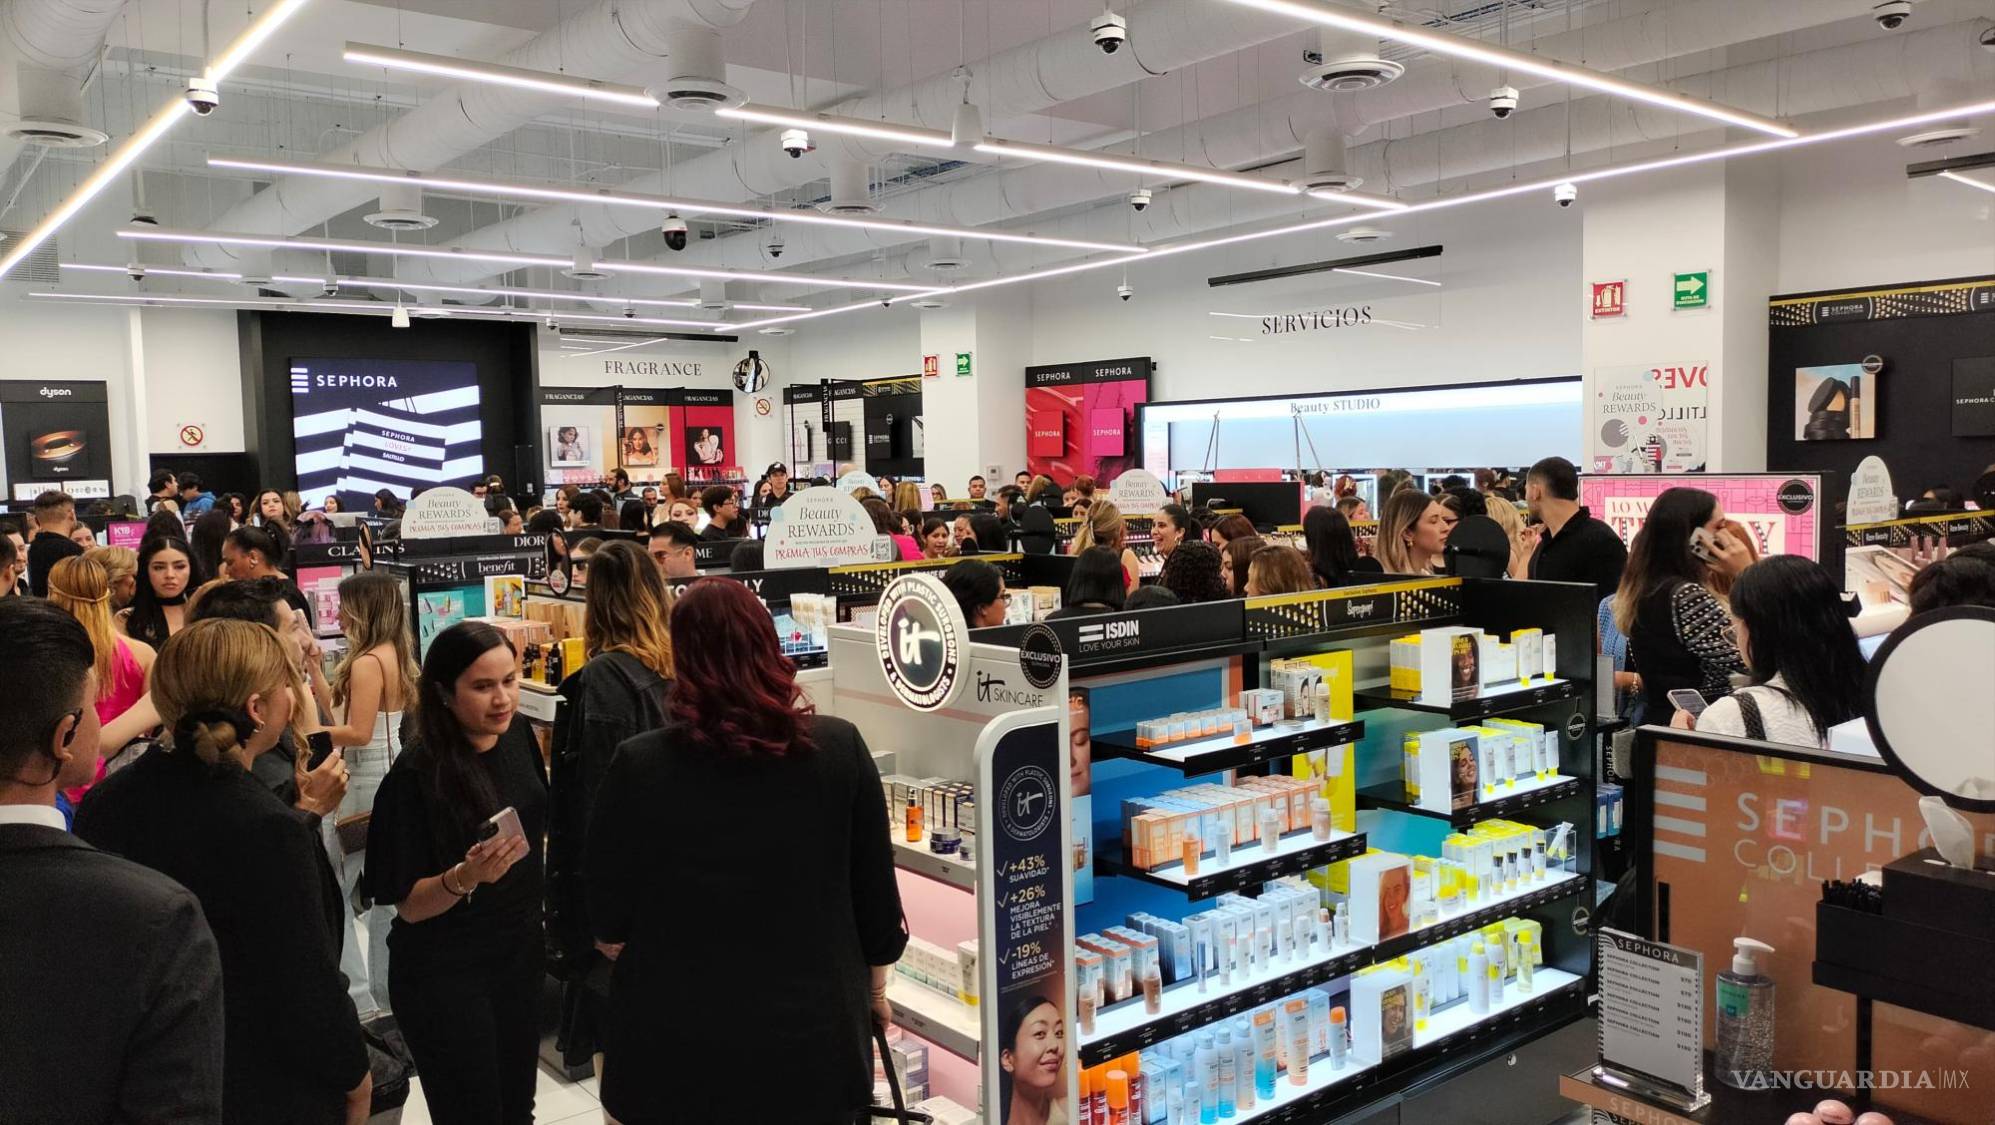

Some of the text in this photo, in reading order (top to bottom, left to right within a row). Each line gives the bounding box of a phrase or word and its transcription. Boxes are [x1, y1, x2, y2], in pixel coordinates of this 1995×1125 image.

[1262, 306, 1372, 335] SERVICIOS
[604, 360, 702, 377] FRAGRANCE
[1095, 367, 1132, 378] SEPHORA
[316, 375, 398, 388] SEPHORA
[1036, 372, 1072, 382] SEPHORA
[40, 387, 72, 398] dyson
[1612, 391, 1646, 403] Beauty
[1290, 398, 1380, 415] Beauty STUDIO
[1603, 402, 1656, 414] REWARDS
[382, 430, 415, 442] SEPHORA
[419, 508, 472, 520] REWARDS
[800, 507, 842, 522] Beauty
[788, 522, 856, 538] REWARDS
[514, 535, 545, 548] DIOR
[328, 543, 405, 558] CLAINS
[775, 548, 810, 561] PREMIA
[829, 544, 869, 557] COMPRAS
[478, 559, 516, 574] benefit
[1105, 620, 1139, 639] ISDIN
[898, 617, 941, 665] it
[1079, 637, 1140, 652] LOVE YOUR SKIN
[1020, 650, 1061, 663] EXCLUSIVO
[976, 670, 1005, 703] it
[993, 687, 1043, 708] SKINCARE
[1016, 792, 1044, 817] it
[1009, 855, 1045, 872] +43%
[1010, 884, 1046, 903] +26%
[1010, 901, 1040, 914] MEJORA
[1010, 902, 1062, 922] VISIBLEMENTE
[1011, 913, 1055, 931] LA TEXTURA
[1011, 930, 1021, 939] DE
[1022, 927, 1032, 936] LA
[1012, 941, 1041, 959] -19%
[1039, 952, 1049, 962] DE
[1618, 939, 1680, 963] SEPHORA
